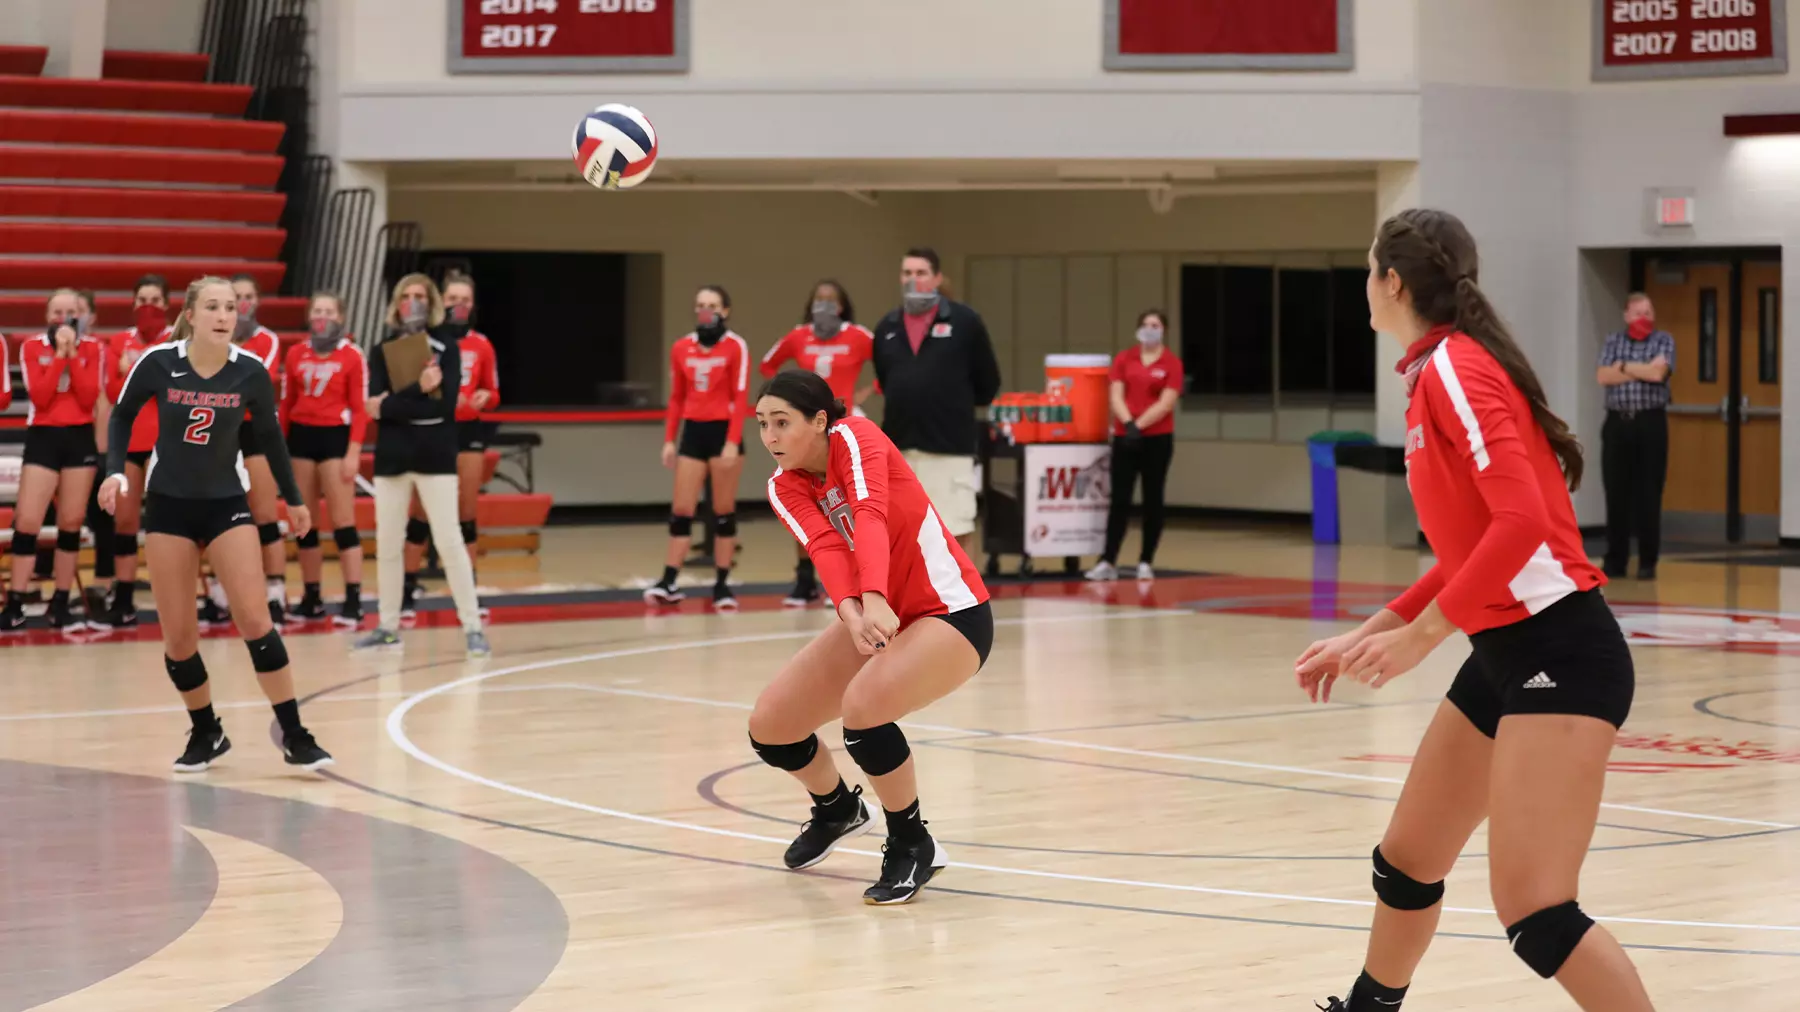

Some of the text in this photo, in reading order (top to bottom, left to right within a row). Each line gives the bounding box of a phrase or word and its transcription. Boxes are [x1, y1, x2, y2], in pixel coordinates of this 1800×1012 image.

[480, 0, 558, 15] 2014
[1613, 0, 1755, 23] 2005 2006
[480, 24, 558, 48] 2017
[1613, 28, 1757, 56] 2007 2008
[302, 366, 335, 397] 17
[167, 387, 241, 408] WILDCATS
[182, 407, 215, 446] 2
